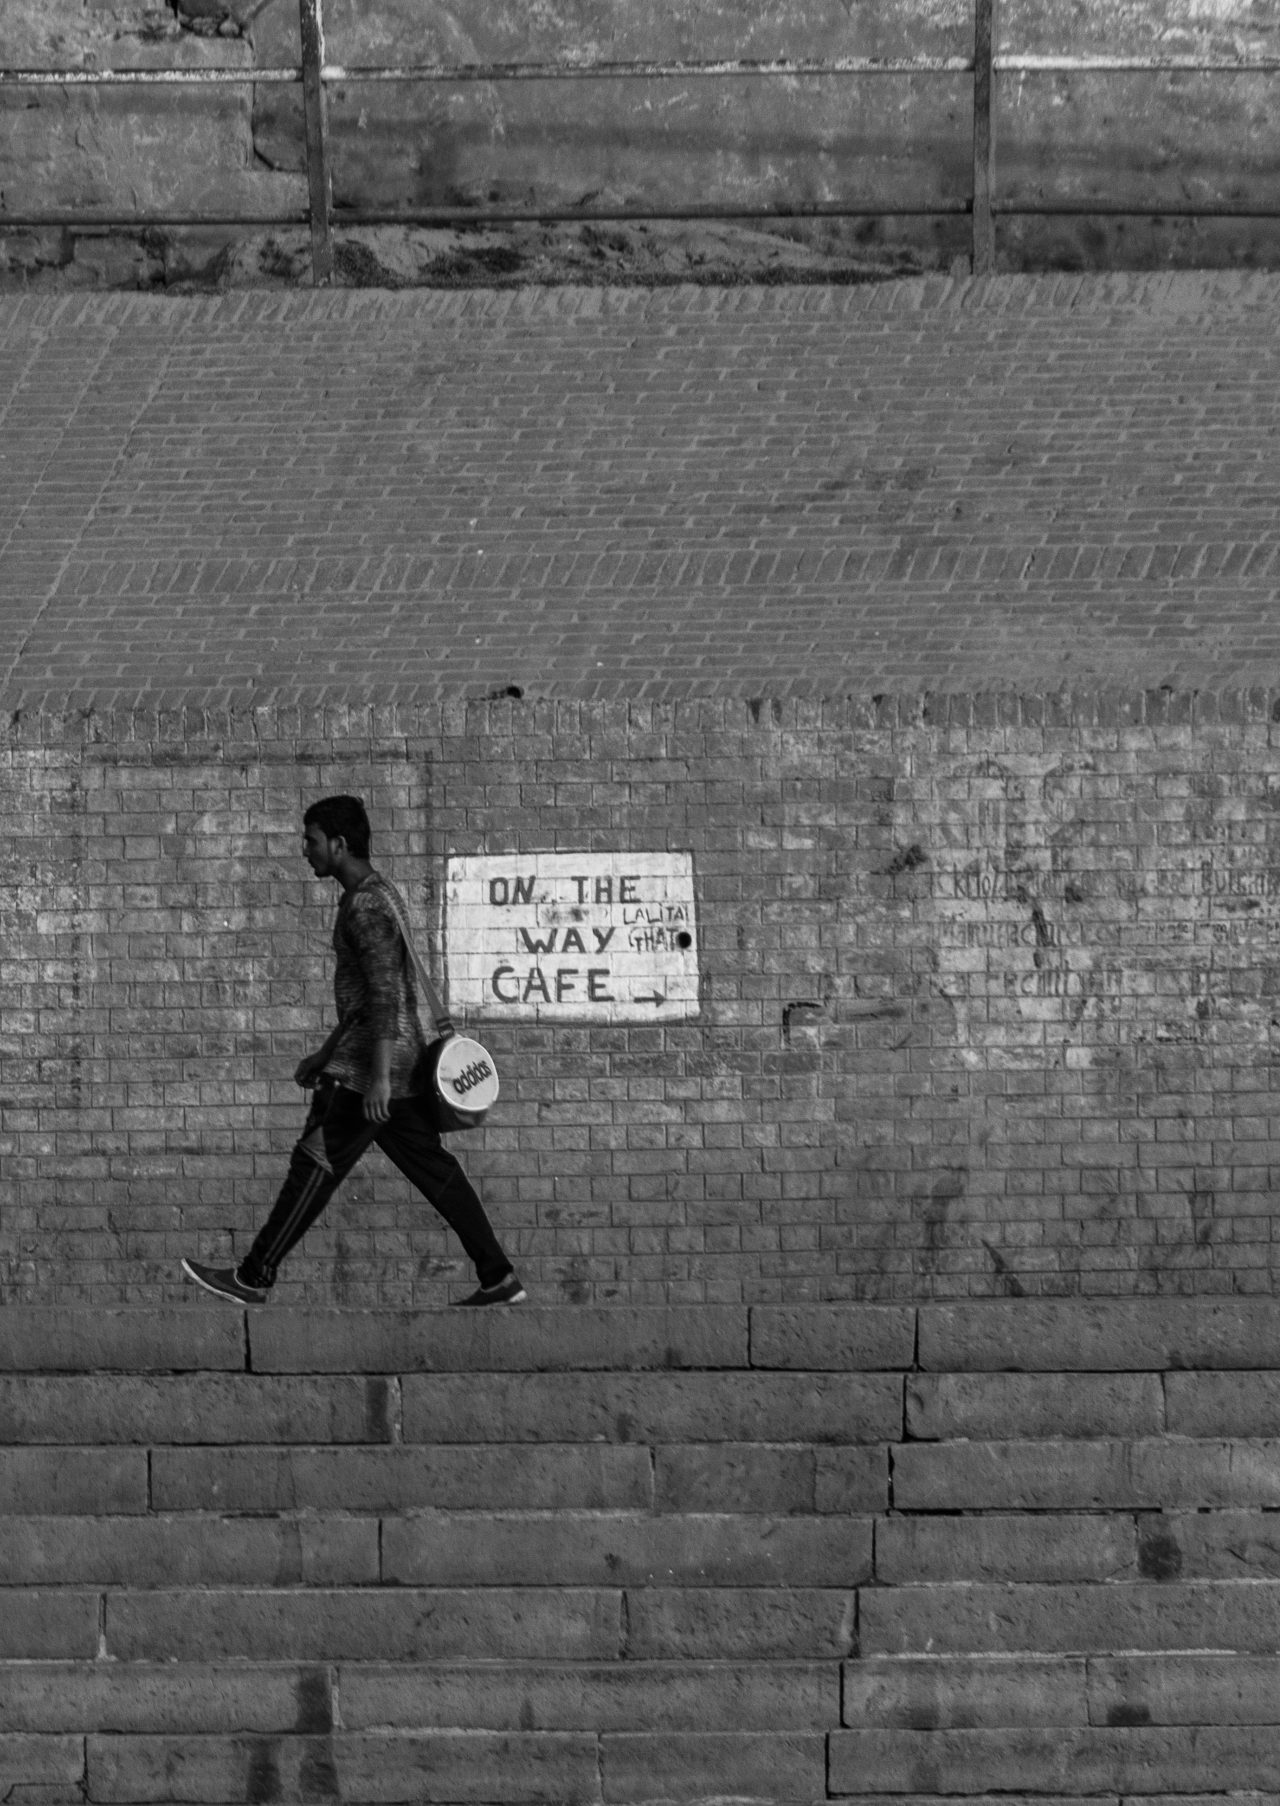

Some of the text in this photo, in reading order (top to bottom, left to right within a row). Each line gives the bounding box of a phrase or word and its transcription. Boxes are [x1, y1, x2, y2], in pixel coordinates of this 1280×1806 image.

[489, 875, 641, 906] ON THE
[520, 927, 615, 954] WAY
[492, 966, 615, 1003] CAFE
